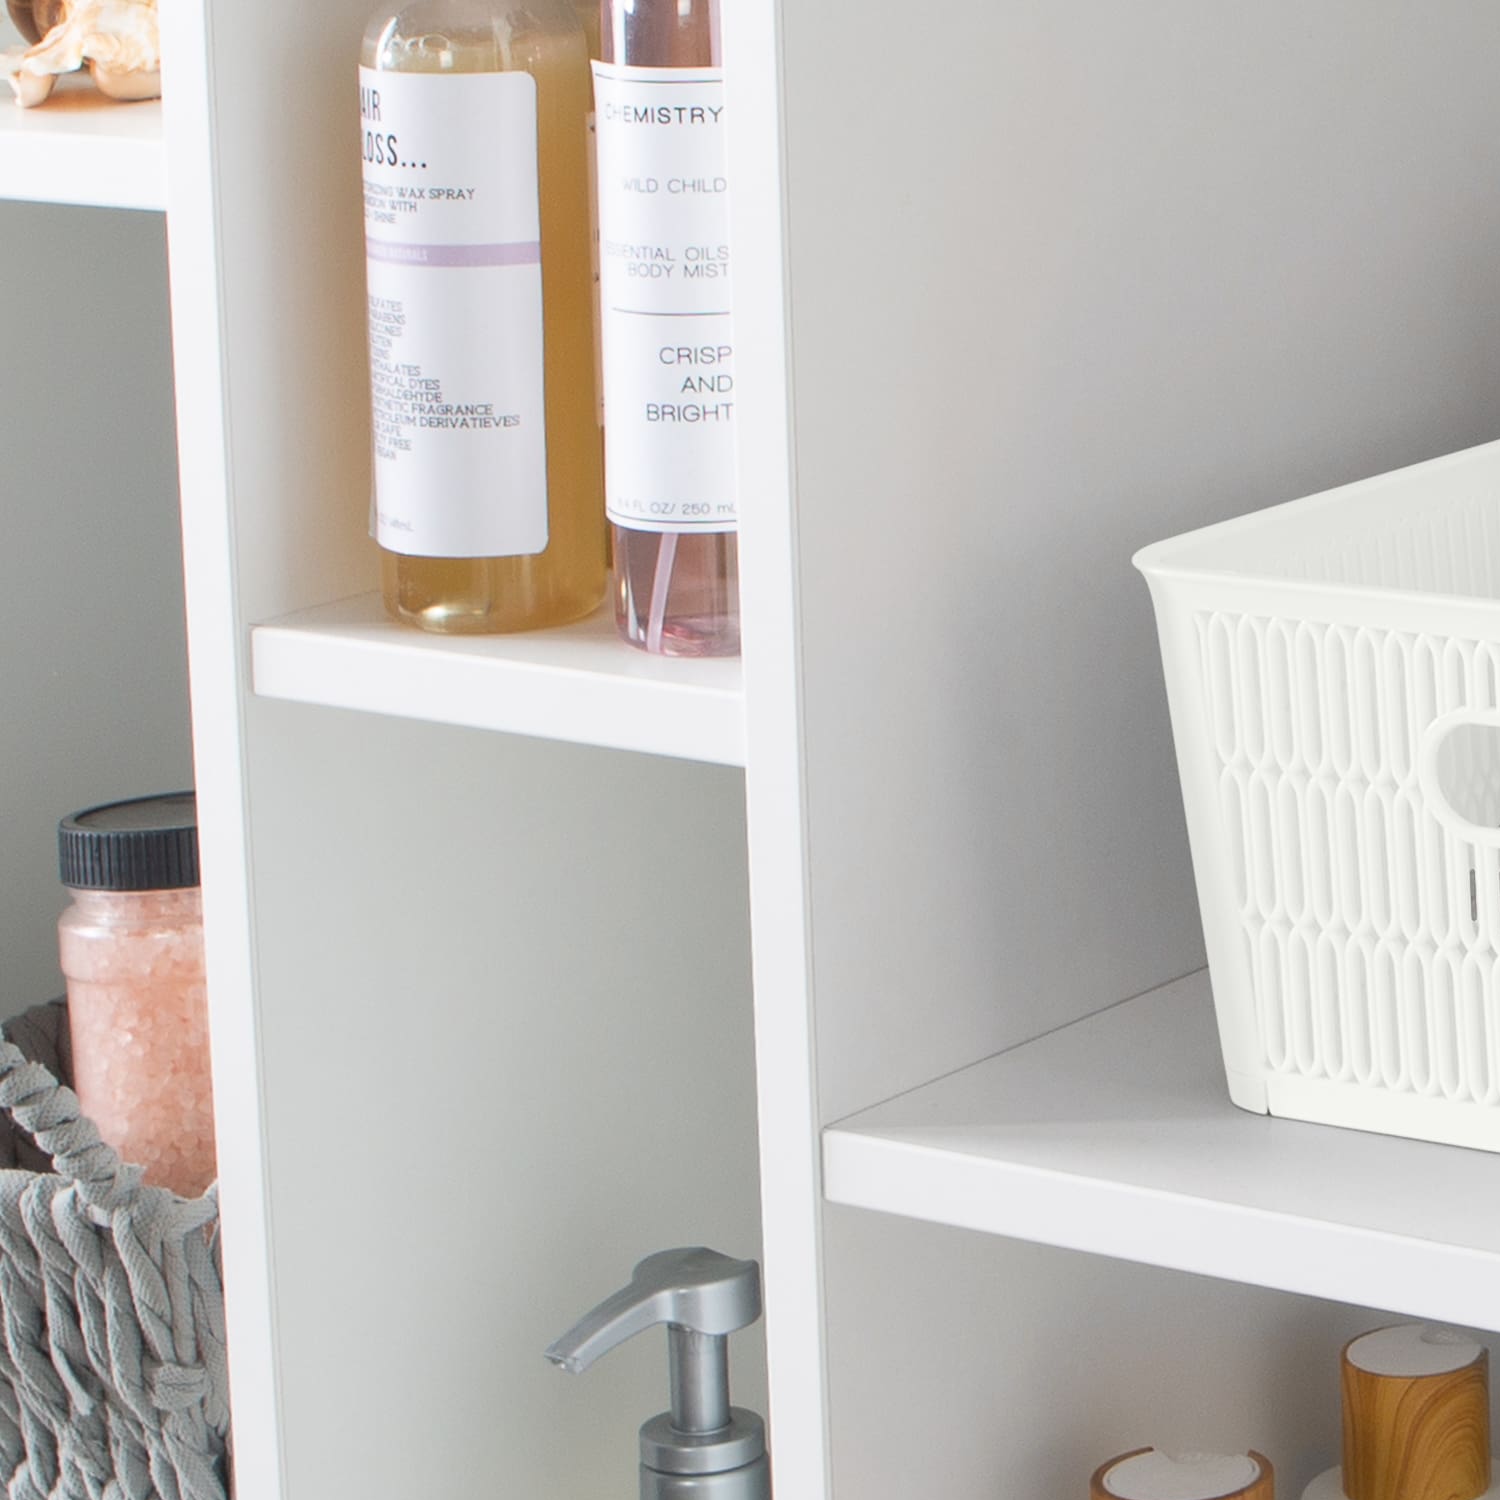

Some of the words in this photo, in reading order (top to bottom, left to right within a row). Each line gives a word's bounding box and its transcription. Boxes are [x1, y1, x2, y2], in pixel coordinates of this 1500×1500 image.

[605, 103, 724, 124] CHEMISTRY
[397, 187, 426, 200] WAX
[428, 188, 475, 201] SPRAY
[667, 177, 728, 194] CHILD
[684, 245, 730, 262] OILS
[628, 263, 675, 279] BODY
[684, 263, 729, 278] MIST
[659, 346, 733, 365] CRISP
[408, 378, 440, 391] DYES
[680, 375, 734, 393] AND
[411, 404, 494, 417] FRAGRANCE
[646, 402, 734, 423] BRIGHT
[682, 503, 711, 516] 250
